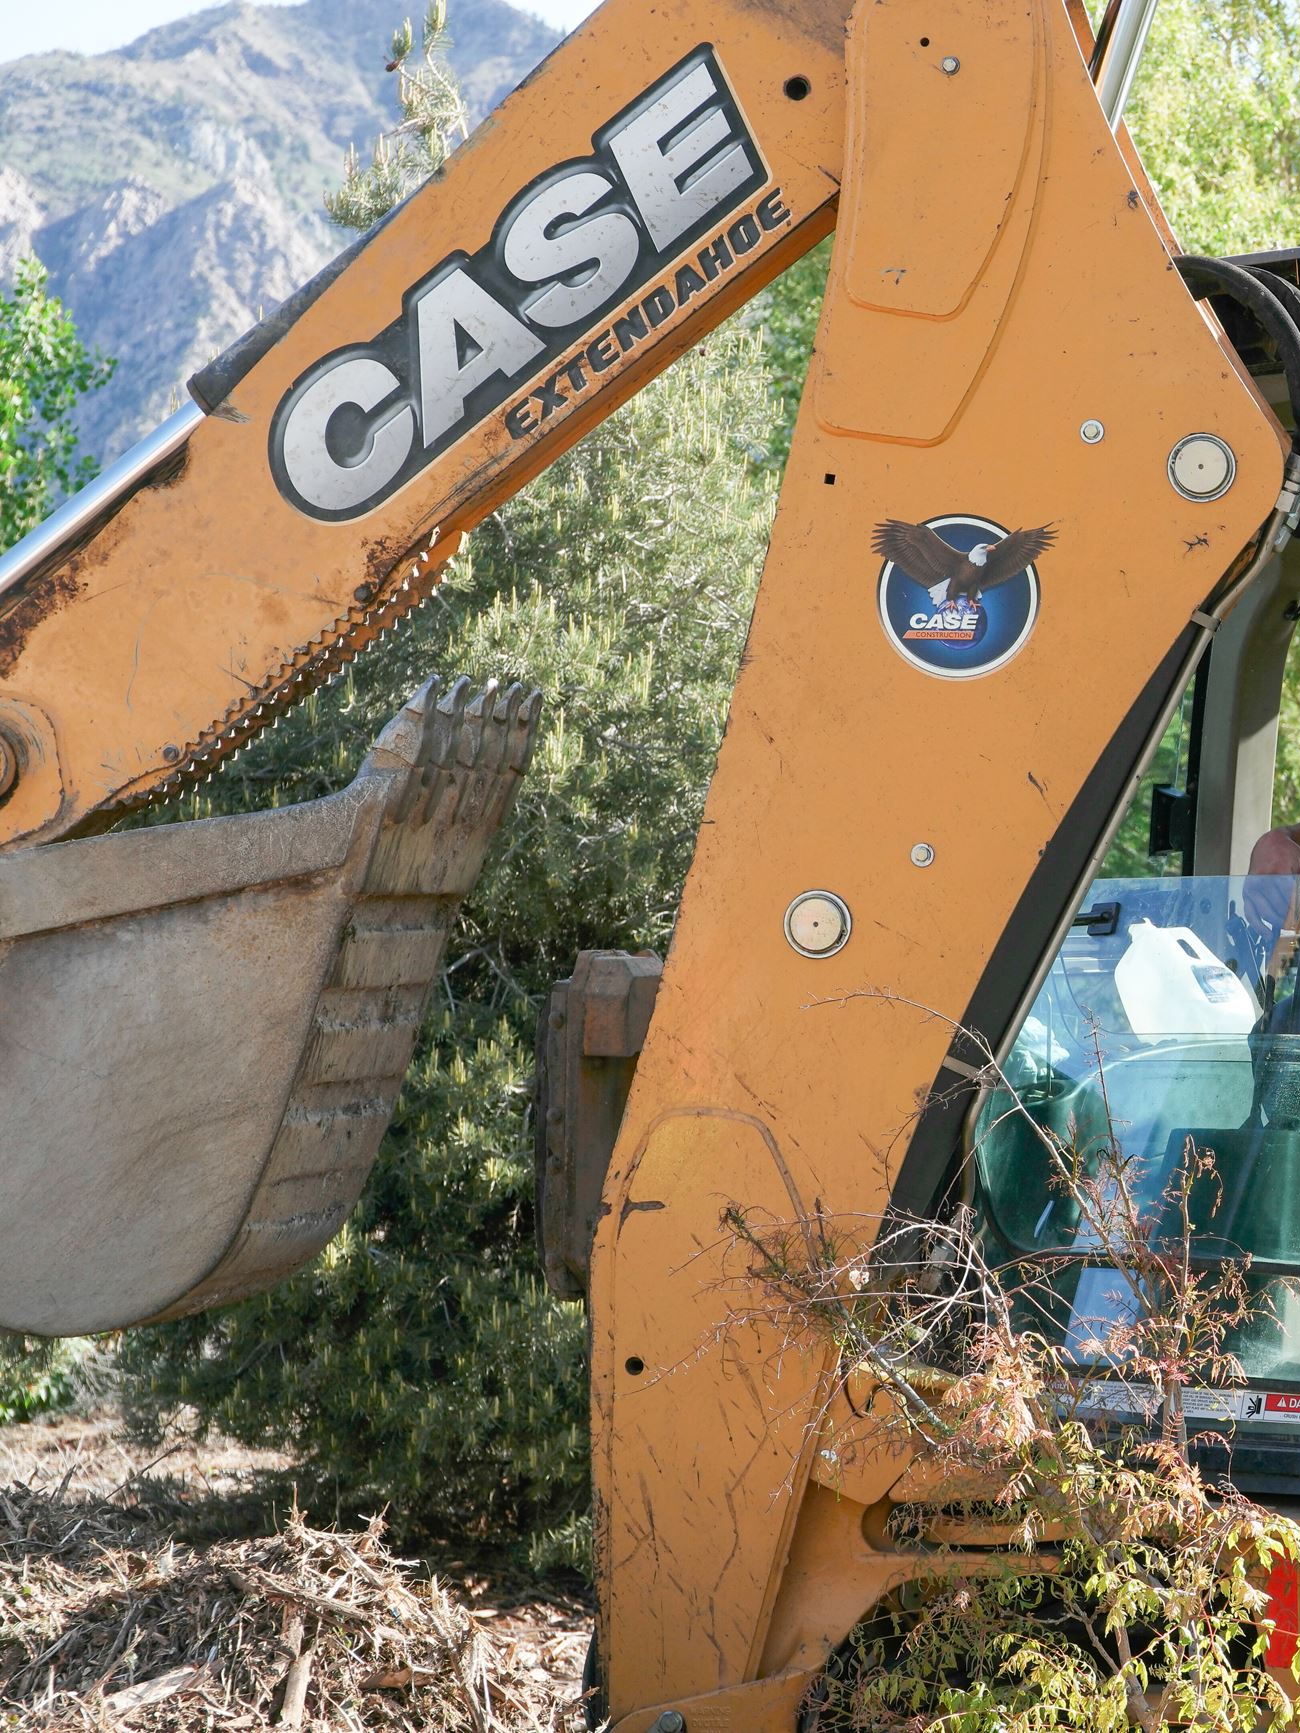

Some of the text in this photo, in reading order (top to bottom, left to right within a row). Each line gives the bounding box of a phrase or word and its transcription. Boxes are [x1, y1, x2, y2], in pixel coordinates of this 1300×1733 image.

[278, 56, 763, 515] CASE
[505, 187, 792, 441] EXTENDAHOE
[909, 613, 979, 630] CASE
[915, 631, 972, 640] CONSTRUCTION
